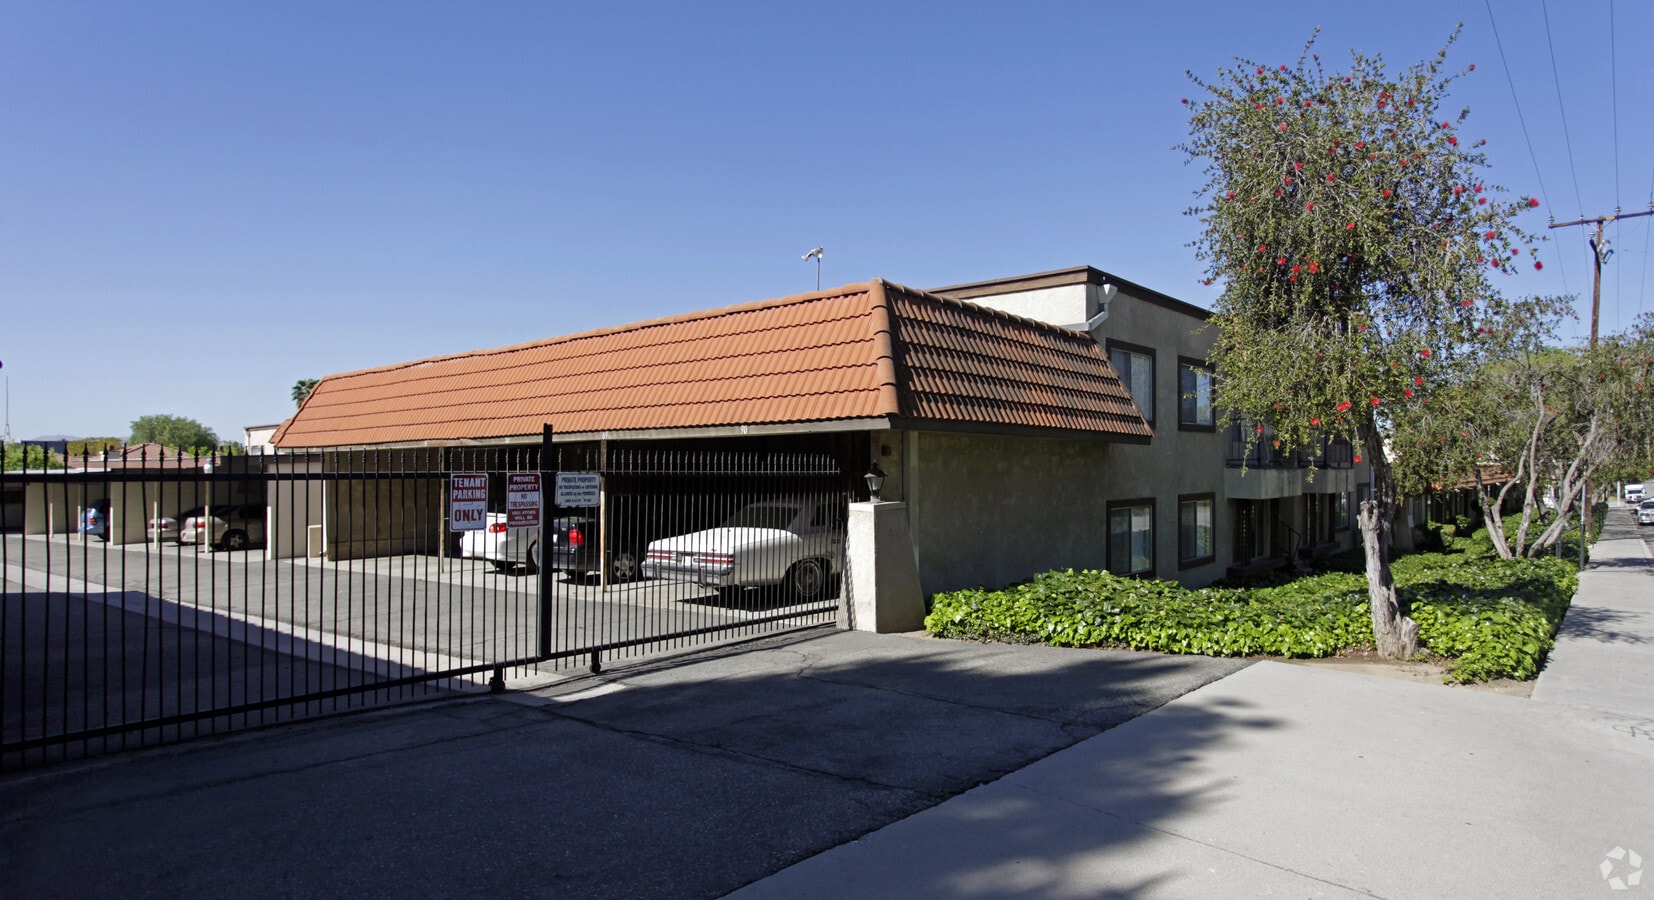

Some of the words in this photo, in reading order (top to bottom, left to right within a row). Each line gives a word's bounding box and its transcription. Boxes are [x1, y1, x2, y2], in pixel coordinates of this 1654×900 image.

[454, 477, 486, 488] TENANT
[509, 483, 539, 491] PROPERTY
[454, 489, 486, 500] PARKING
[510, 500, 538, 508] TRESPASSING
[454, 508, 484, 522] ONLY
